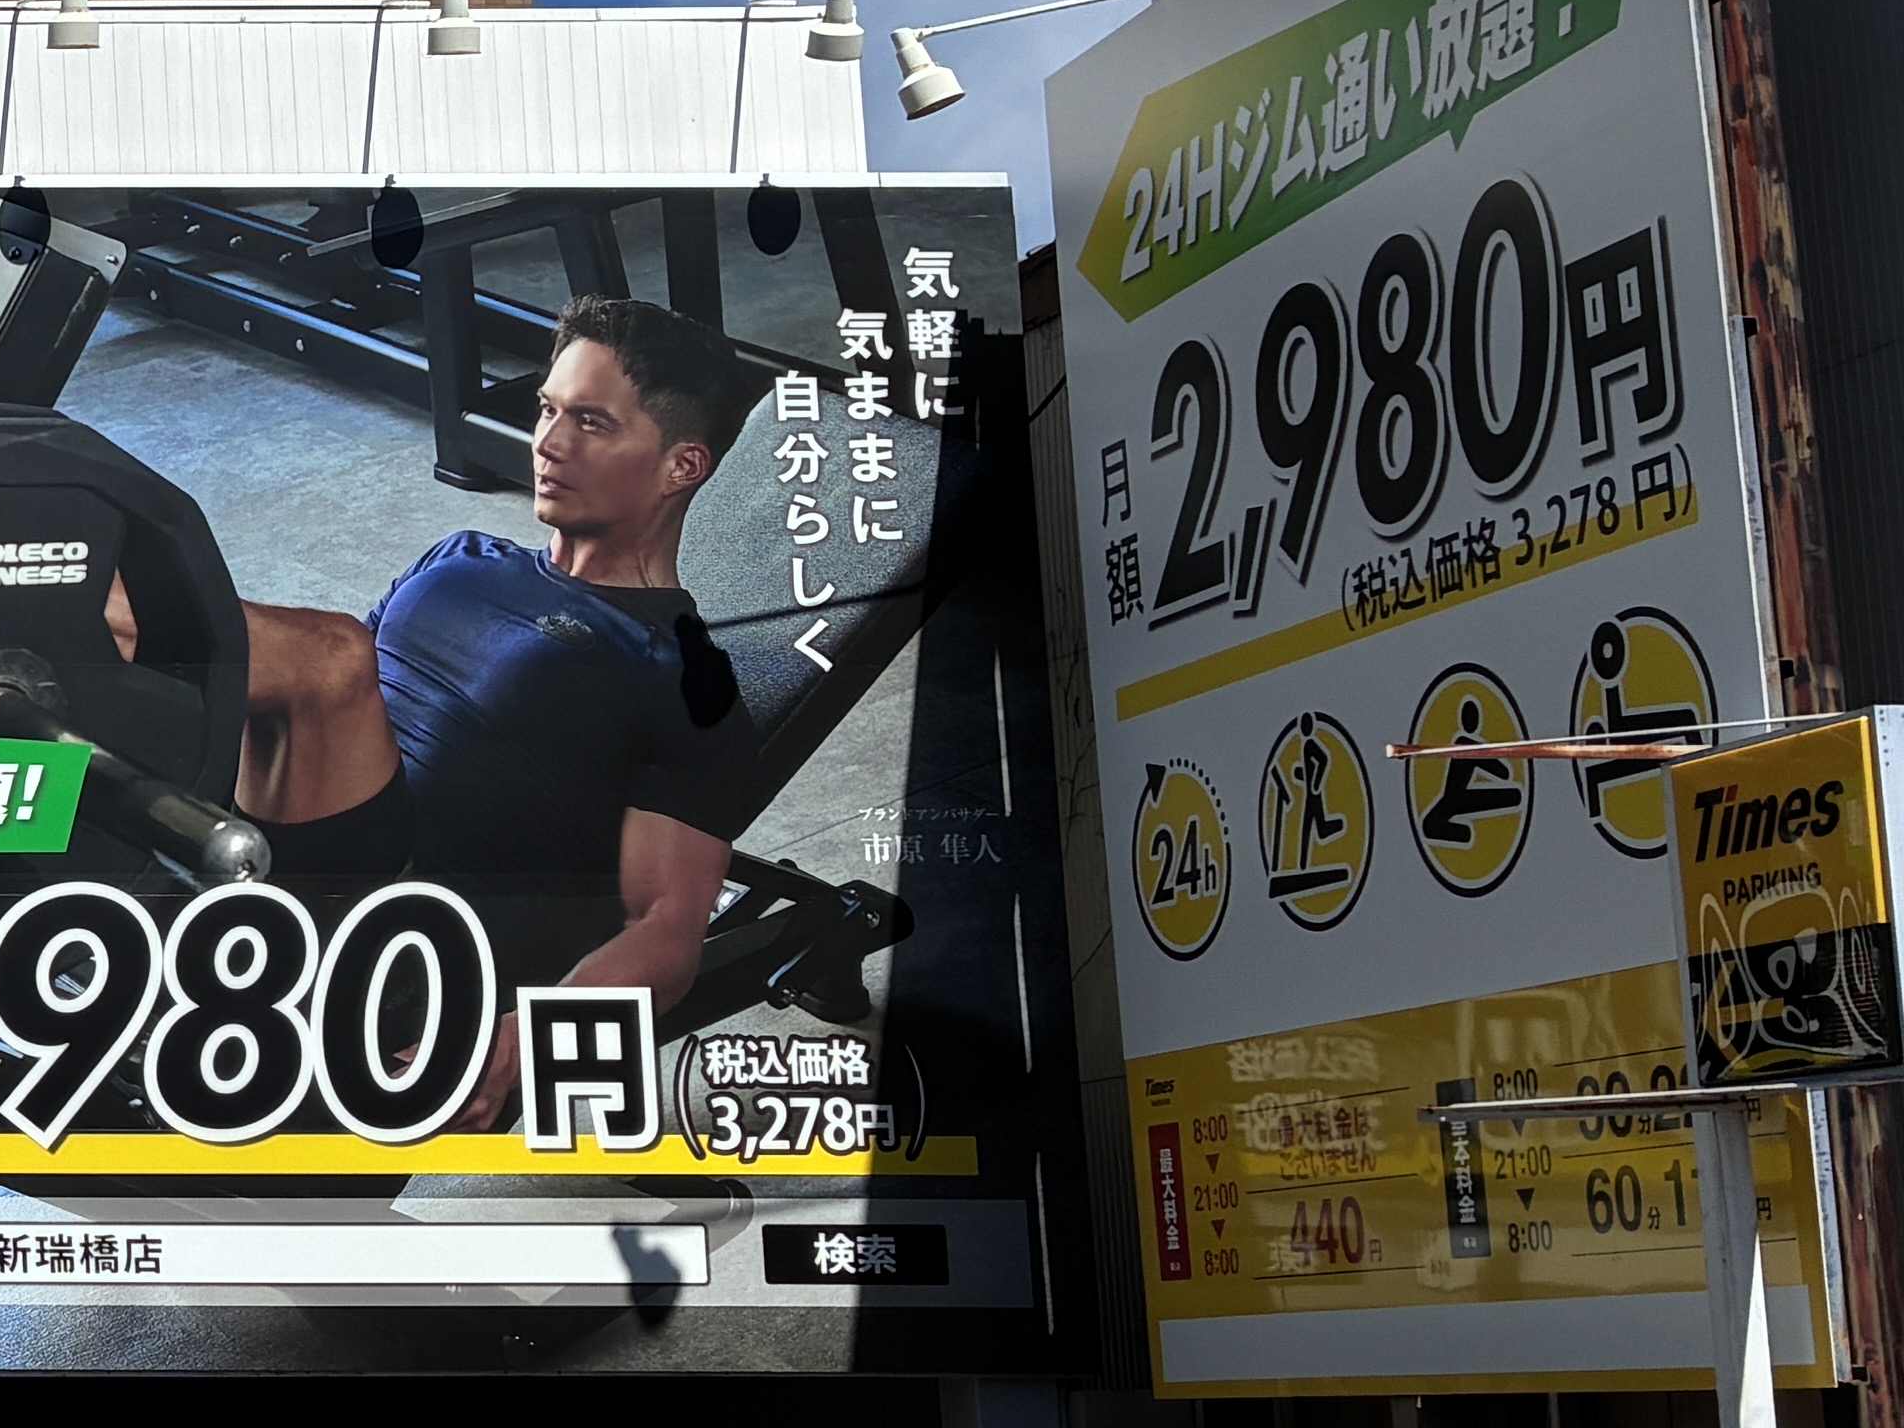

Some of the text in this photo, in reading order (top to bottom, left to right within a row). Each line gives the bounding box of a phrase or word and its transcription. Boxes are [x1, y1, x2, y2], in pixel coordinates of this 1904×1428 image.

[903, 247, 964, 417] 気軽に
[1147, 176, 1682, 630] 2,980円
[836, 309, 903, 543] 気ままに
[773, 372, 835, 672] 自分らしく
[1100, 438, 1145, 627] 月額
[858, 806, 1000, 822] ブランドアンバサダー
[1695, 780, 1845, 862] Times
[1150, 818, 1218, 908] 24h
[1724, 861, 1823, 906] PARKING
[1145, 1078, 1176, 1097] Times
[1493, 1068, 1538, 1100] 8:00
[1193, 1114, 1228, 1144] 8:00
[1277, 1105, 1371, 1147] 最大料金は
[1278, 1140, 1377, 1182] ございません
[1450, 1120, 1477, 1225] 本料金
[1494, 1145, 1552, 1180] 21:00
[1159, 1148, 1181, 1250] 最大料金
[1194, 1181, 1239, 1212] 21:00
[1289, 1195, 1383, 1266] 440円
[1508, 1221, 1553, 1254] 8:00
[814, 1232, 897, 1275] 検索
[1204, 1248, 1240, 1277] 8:00
